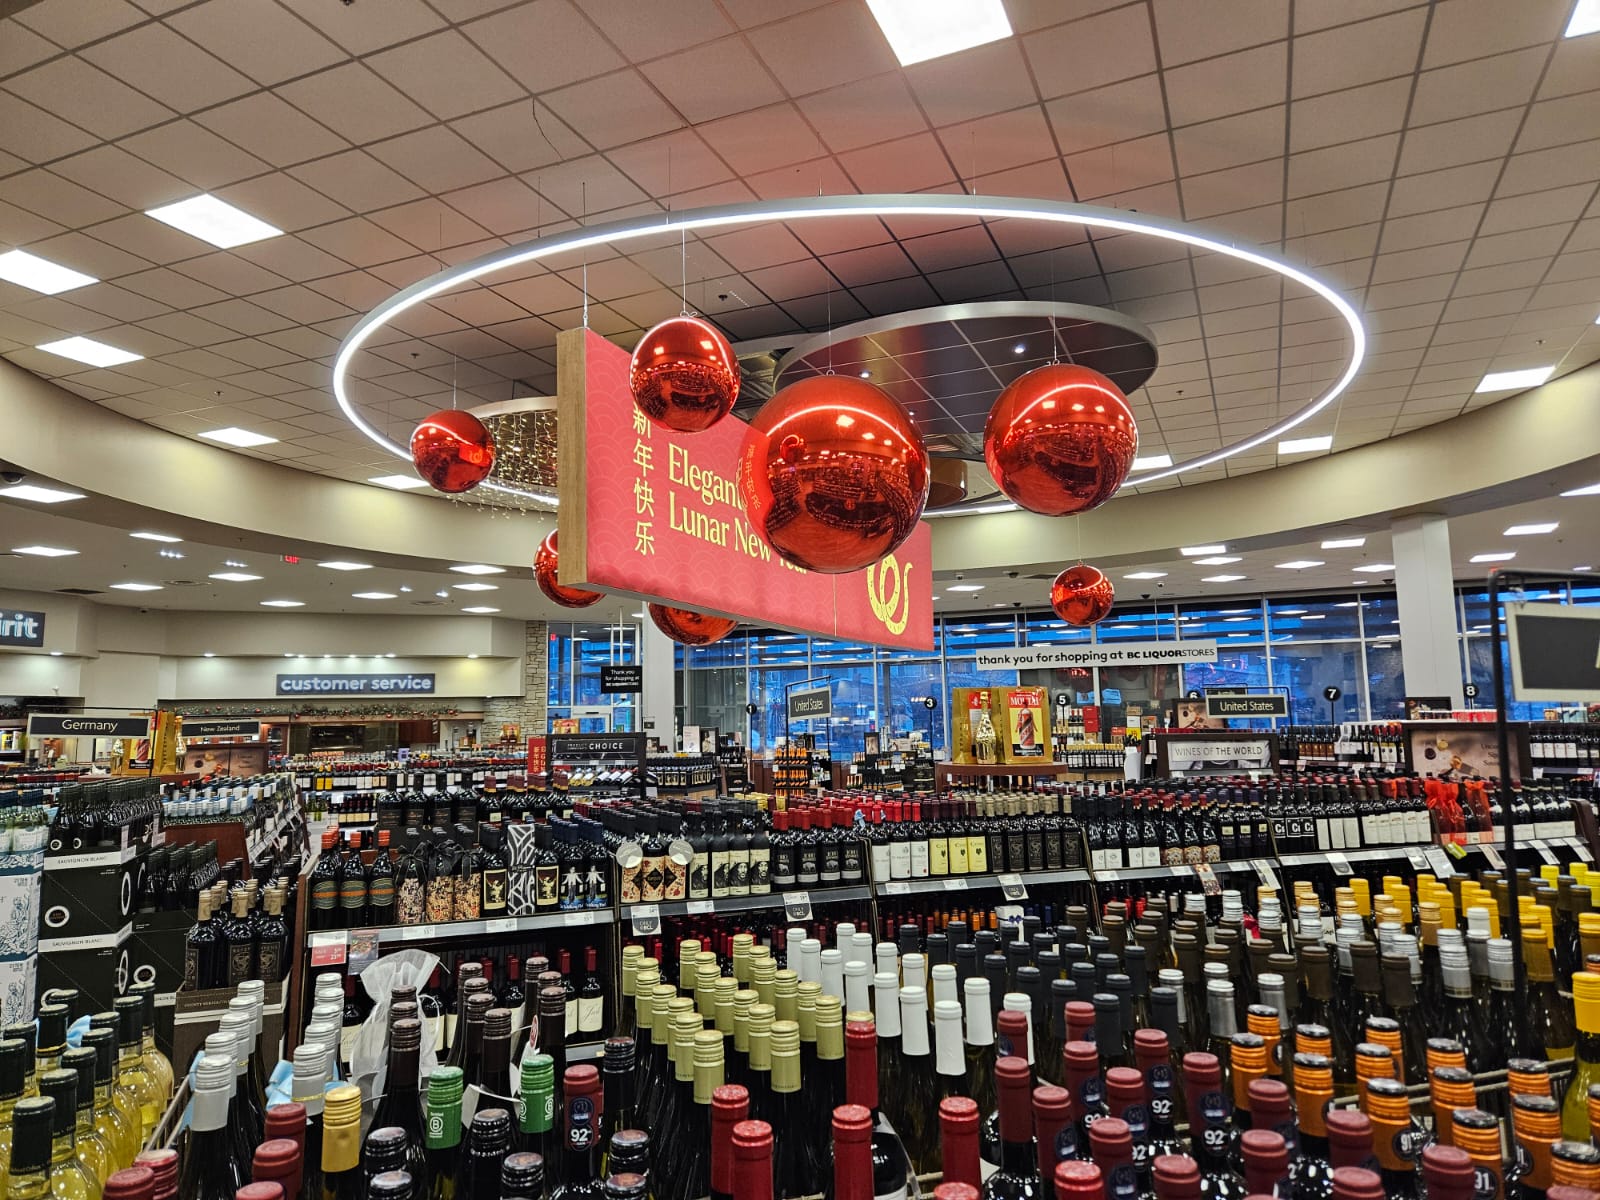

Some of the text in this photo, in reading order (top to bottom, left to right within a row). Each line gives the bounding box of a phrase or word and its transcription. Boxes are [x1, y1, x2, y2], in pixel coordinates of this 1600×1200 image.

[669, 491, 772, 562] Lunar New
[978, 649, 1215, 666] thank you for shopping at BC LIQUORSTORES
[281, 675, 432, 691] customer service
[1328, 689, 1336, 698] 7
[1466, 686, 1475, 696] 8
[794, 698, 824, 712] United States
[926, 699, 934, 708] 3
[1058, 695, 1066, 705] 5
[1220, 700, 1274, 711] United States
[61, 719, 119, 733] Germany
[216, 724, 240, 732] Zealand
[588, 742, 624, 750] CHOICE
[1175, 746, 1263, 756] WINES OF THE WORLD
[1152, 1100, 1170, 1114] 92
[570, 1128, 588, 1142] 92
[1204, 1130, 1224, 1145] 92
